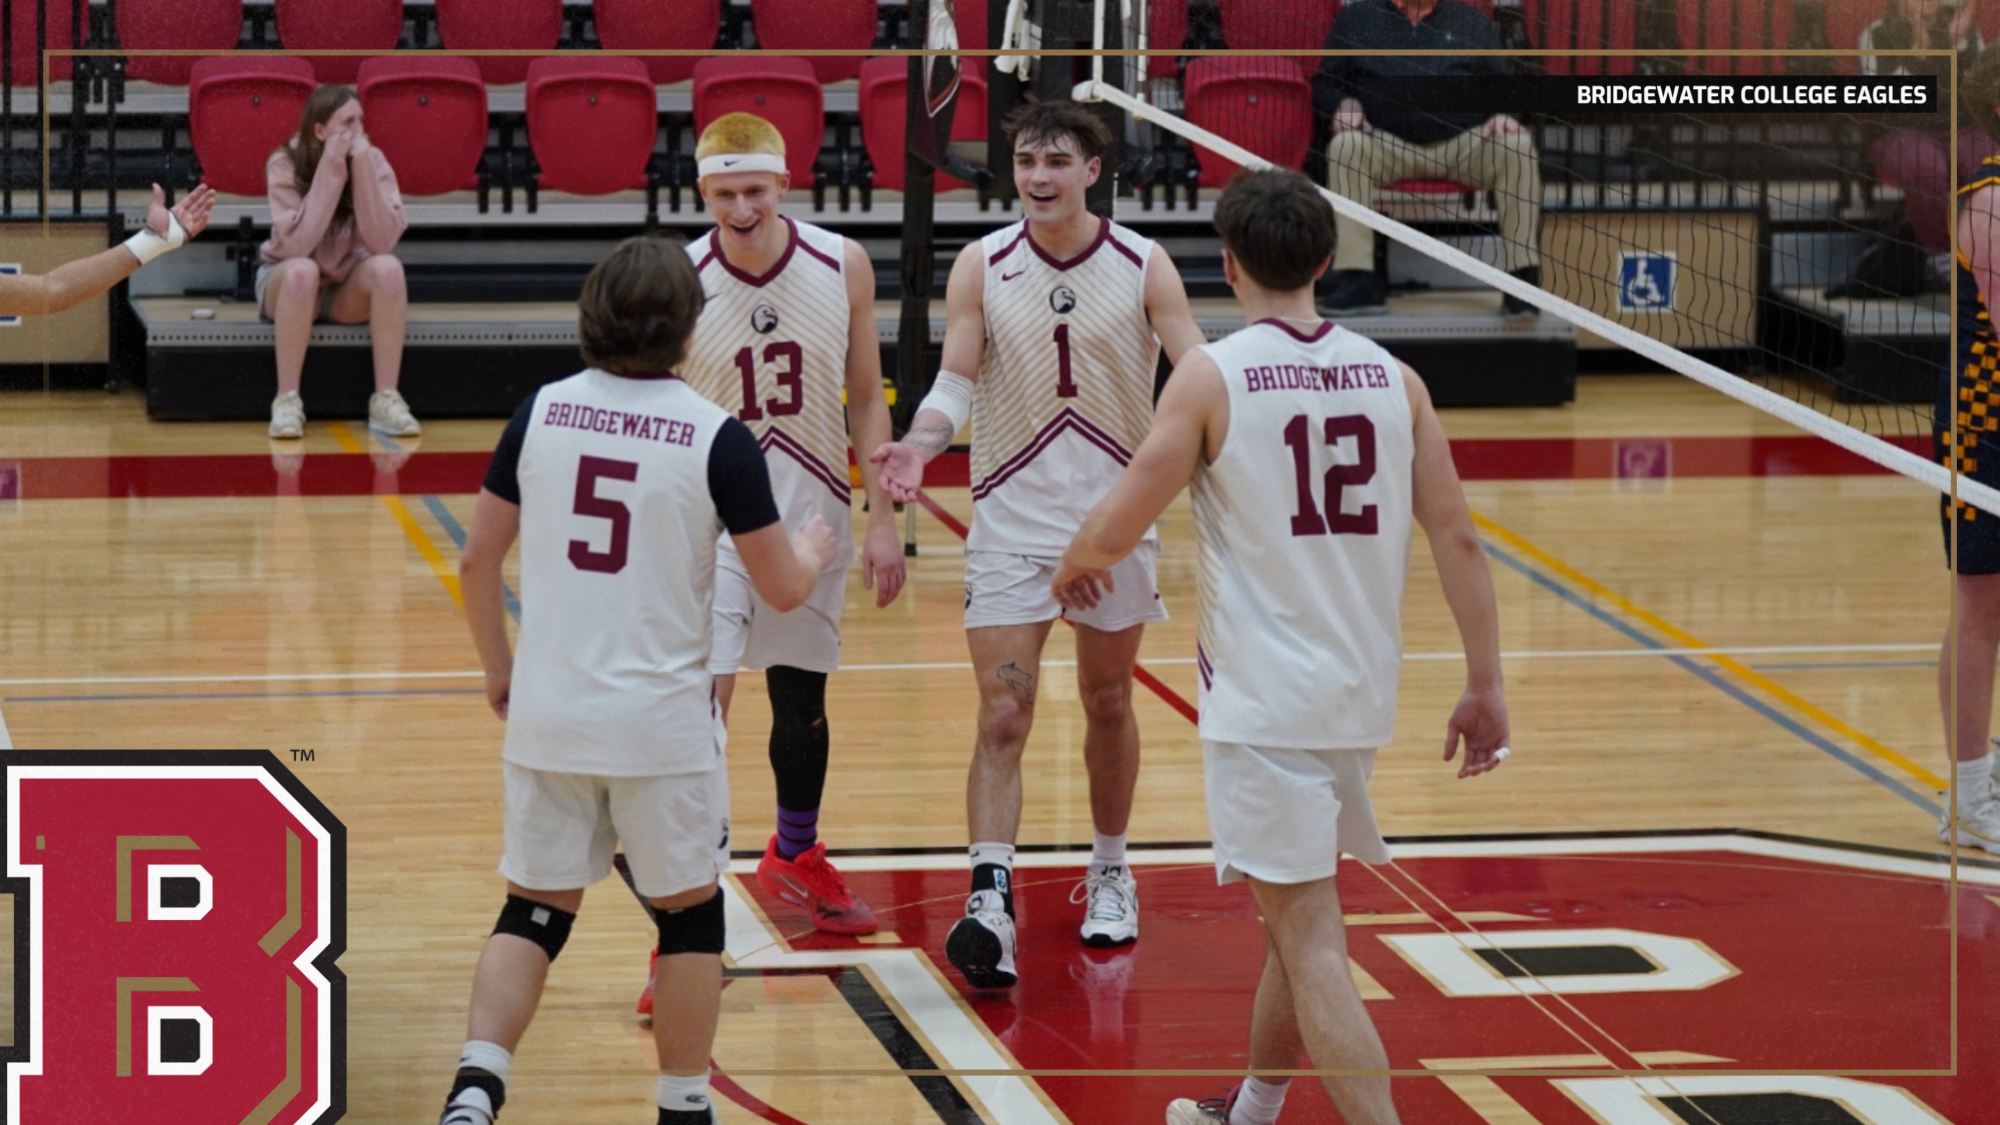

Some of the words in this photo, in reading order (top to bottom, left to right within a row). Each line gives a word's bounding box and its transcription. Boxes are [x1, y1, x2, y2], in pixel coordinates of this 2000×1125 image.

[734, 340, 804, 422] 13
[1053, 323, 1078, 398] 1
[1243, 362, 1390, 393] BRIDGEWATER
[544, 402, 696, 448] BRIDGEWATER
[1283, 413, 1379, 537] 12
[567, 454, 639, 575] 5
